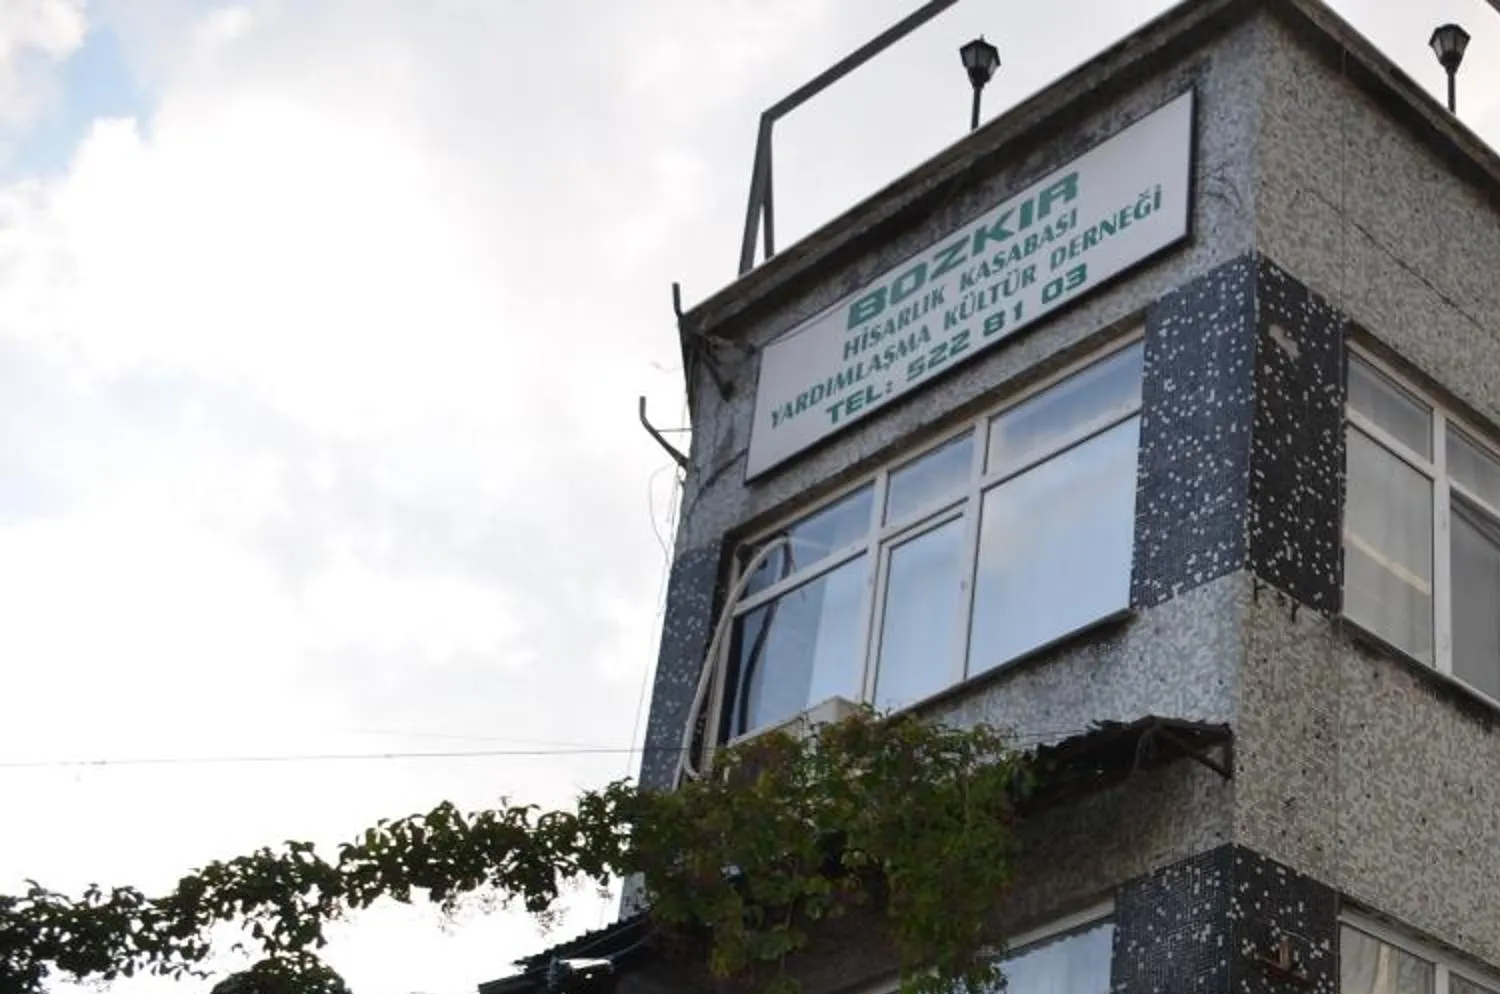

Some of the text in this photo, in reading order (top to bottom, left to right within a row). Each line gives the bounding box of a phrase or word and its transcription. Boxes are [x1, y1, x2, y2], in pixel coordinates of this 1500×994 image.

[770, 184, 1162, 430] YARDIMLAŞMA KÜLTÜR DERNEĞİ
[842, 208, 1079, 361] HİSARLIK KASABASI
[846, 170, 1080, 331] BOZKIR
[825, 262, 1089, 426] TEL: 522 81 03
